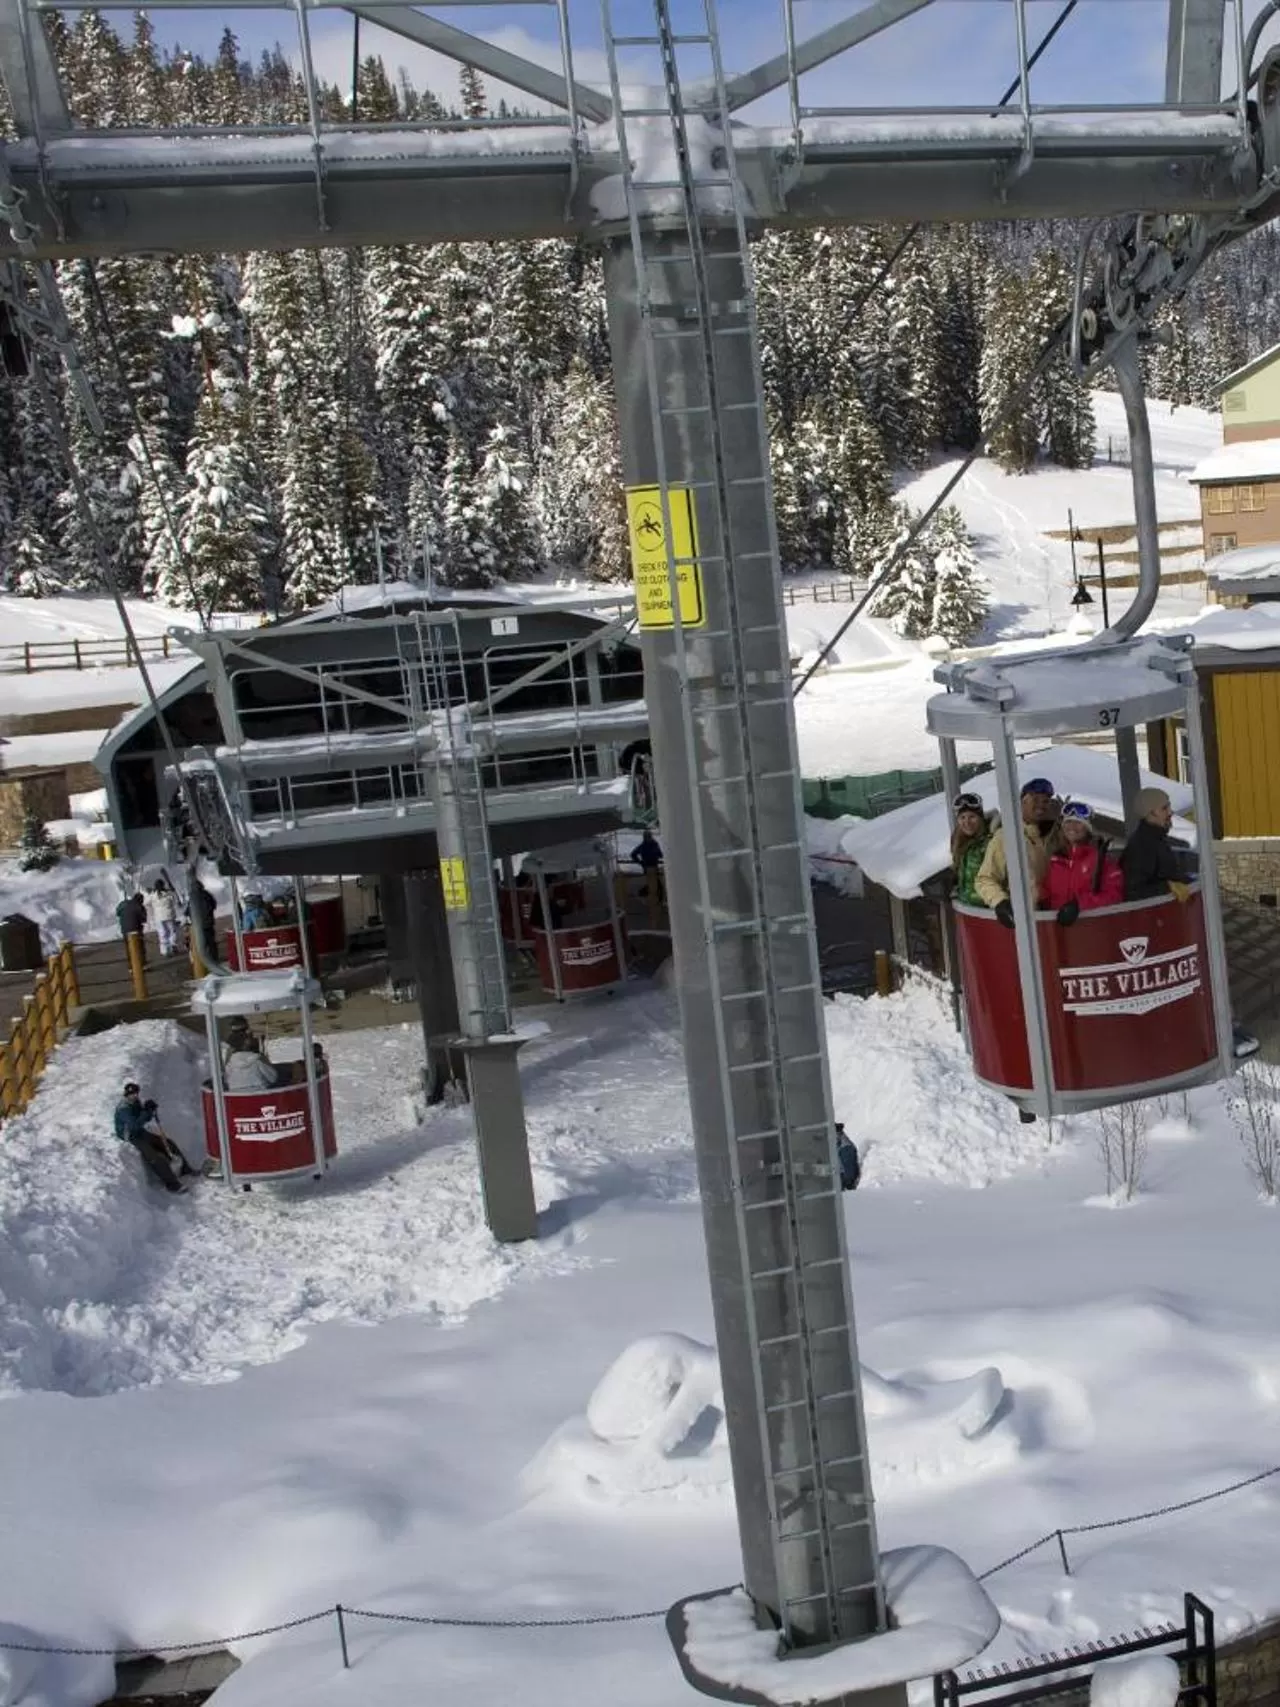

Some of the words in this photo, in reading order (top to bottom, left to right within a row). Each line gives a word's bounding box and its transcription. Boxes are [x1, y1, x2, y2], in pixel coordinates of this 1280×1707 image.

[1099, 708, 1120, 726] 37
[1062, 977, 1110, 999] THE
[1116, 957, 1200, 994] VILLAGE
[235, 1122, 257, 1133] THE
[259, 1116, 305, 1132] VILLAGE
